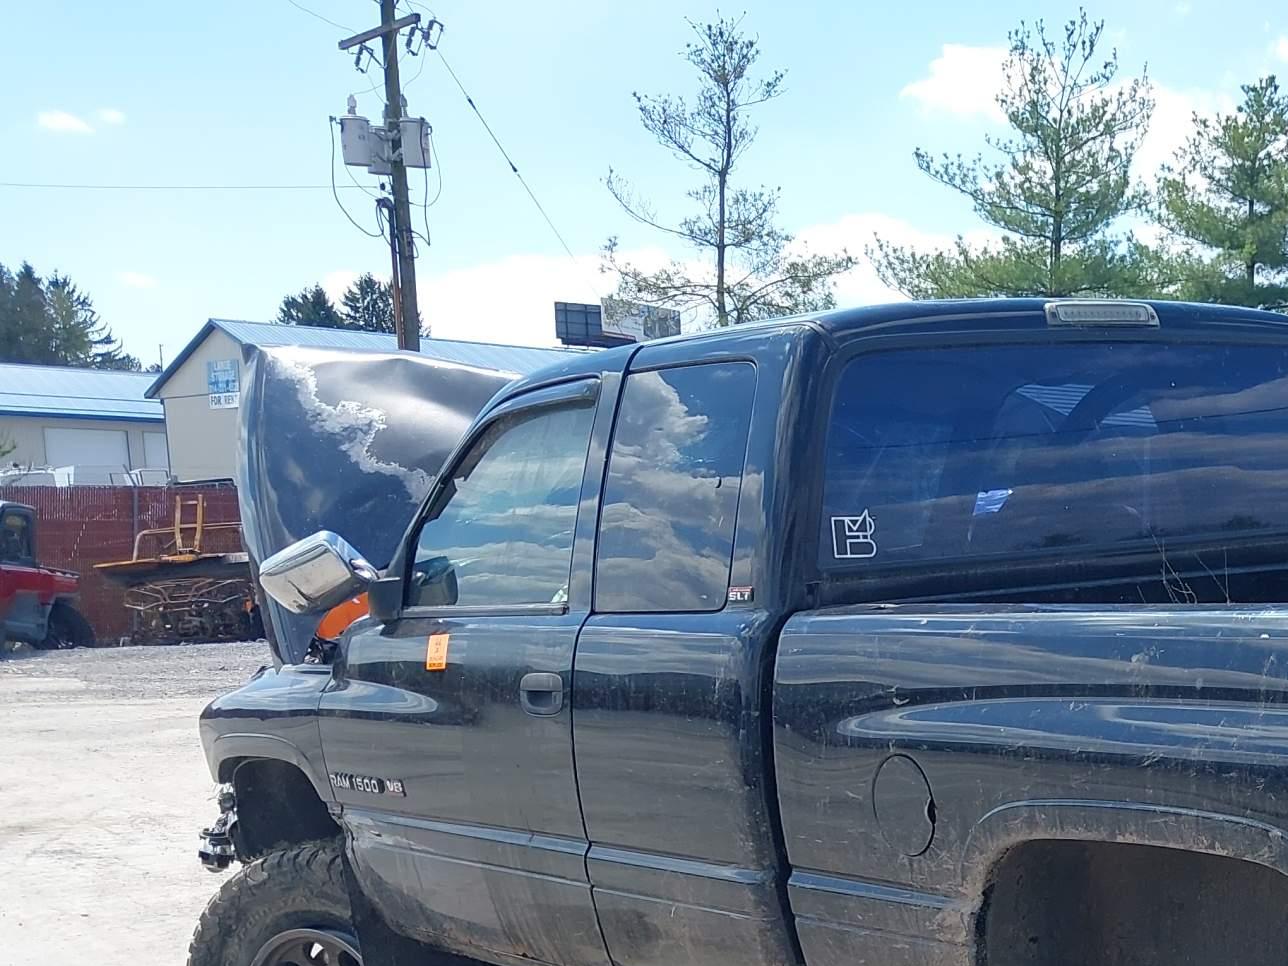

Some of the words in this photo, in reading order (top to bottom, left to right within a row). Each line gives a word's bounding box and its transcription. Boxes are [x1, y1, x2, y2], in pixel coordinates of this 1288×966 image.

[210, 395, 222, 406] FOR
[729, 591, 750, 601] SLT
[329, 773, 350, 790] RAM
[352, 777, 379, 793] 1500
